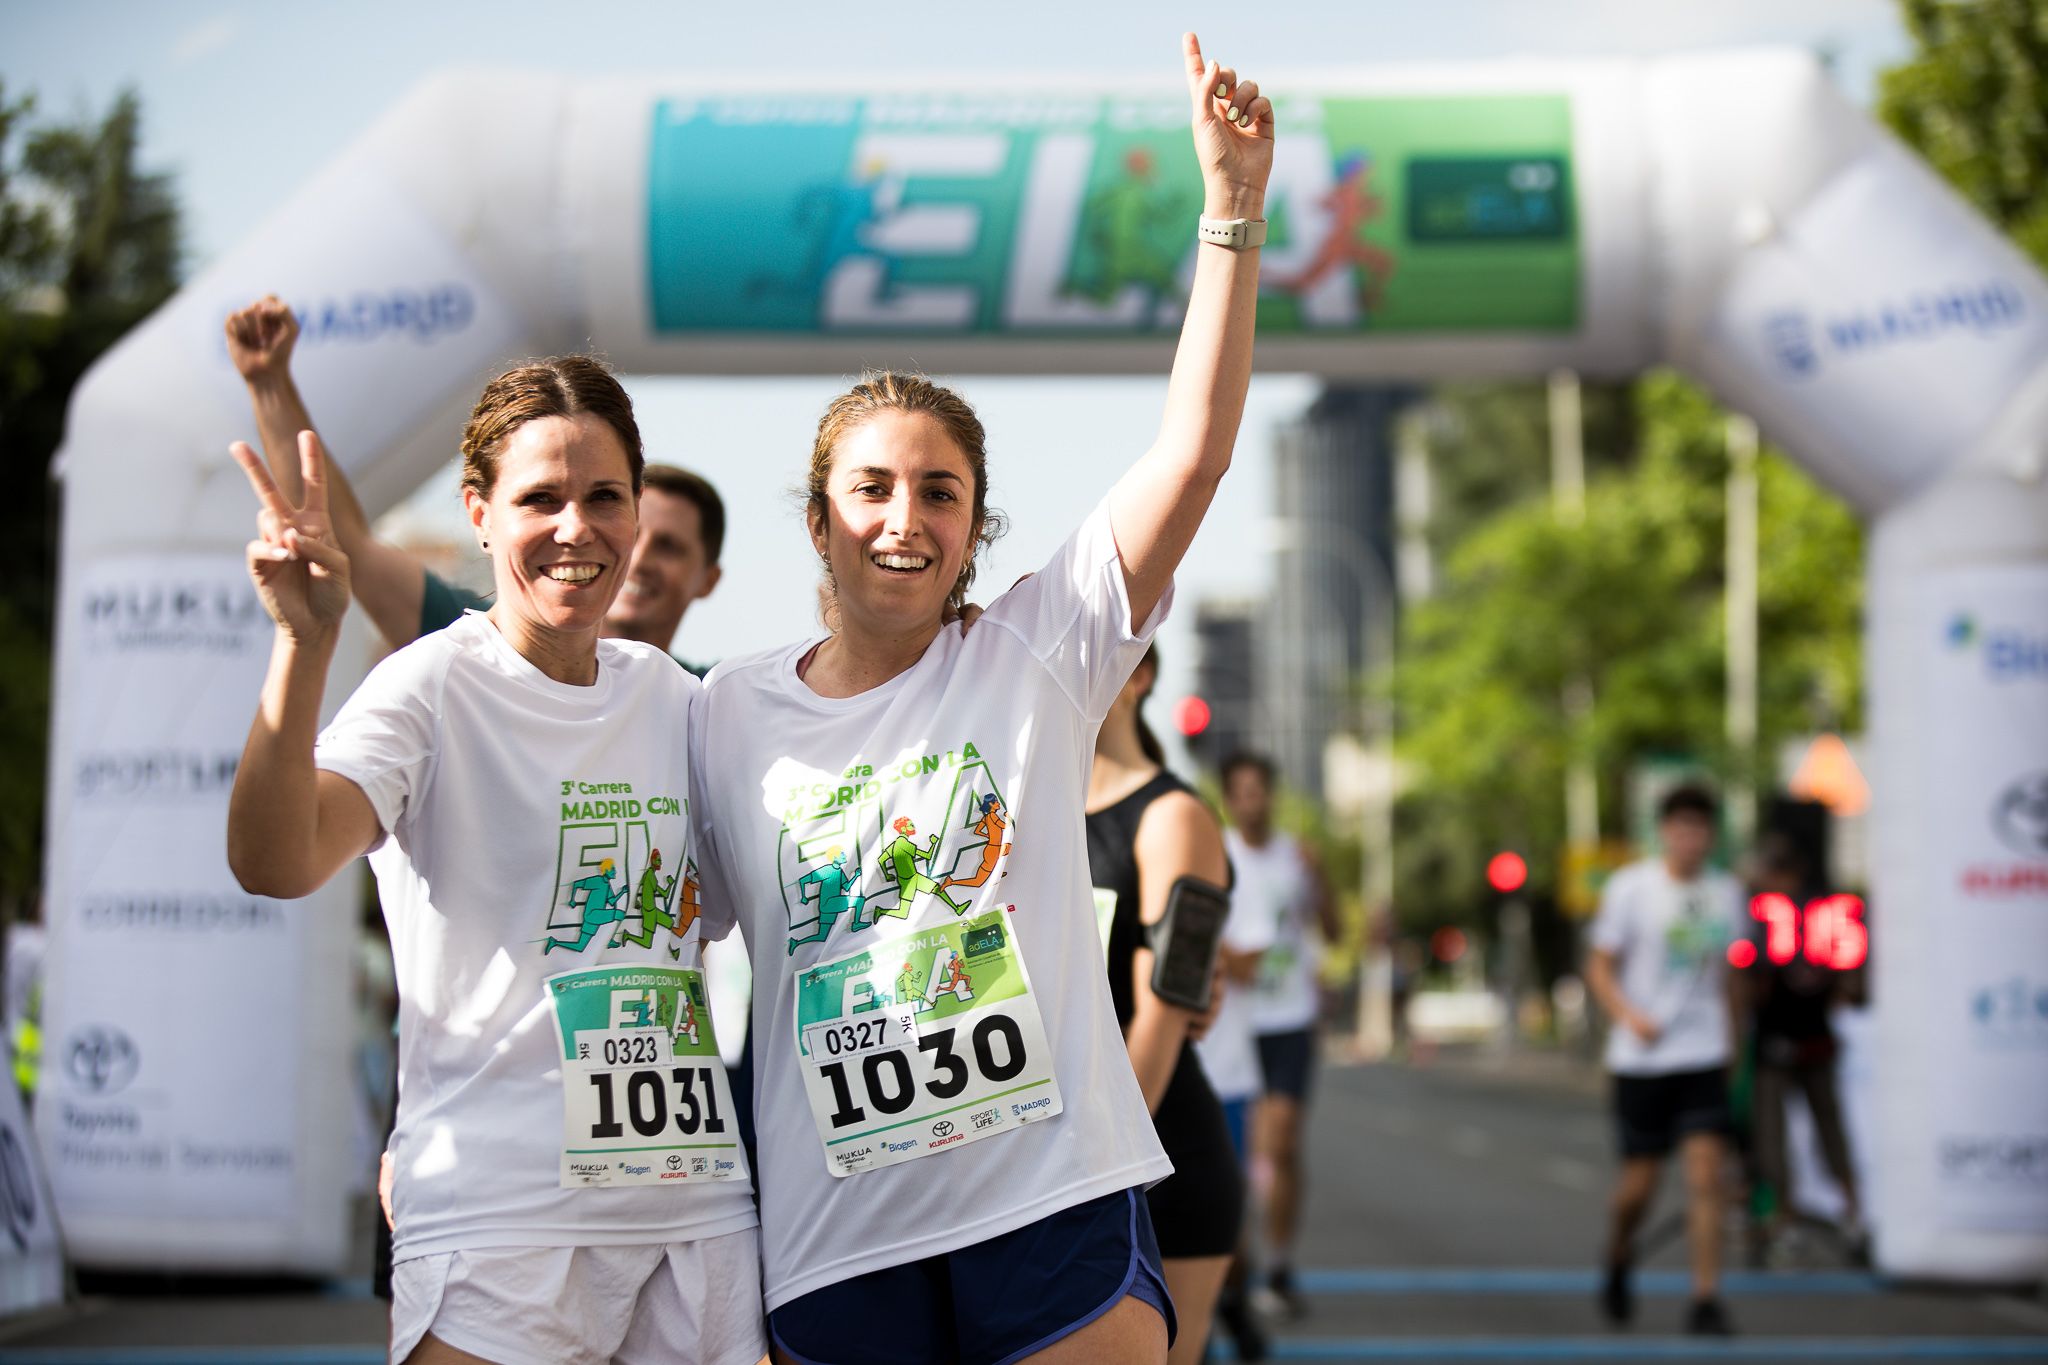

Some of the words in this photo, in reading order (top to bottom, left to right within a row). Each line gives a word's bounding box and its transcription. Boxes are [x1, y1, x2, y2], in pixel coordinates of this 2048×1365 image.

[85, 581, 277, 625] MUKU
[946, 741, 981, 769] LA
[578, 781, 633, 795] Carrera
[560, 799, 642, 821] MADRID
[646, 796, 681, 816] CON
[930, 933, 948, 948] LA
[968, 936, 1000, 953] adELA
[571, 978, 608, 990] Carrera
[610, 974, 655, 987] MADRID
[656, 975, 673, 987] CON
[900, 1015, 913, 1034] 5K
[825, 1017, 888, 1056] 0327
[579, 1042, 591, 1061] 5K
[604, 1036, 658, 1066] 0323
[820, 1014, 1027, 1129] 1030
[590, 1067, 725, 1138] 1031
[1020, 1097, 1051, 1112] MADRID
[969, 1108, 994, 1122] SPORT
[975, 1117, 994, 1129] LIFE
[888, 1139, 918, 1153] Biogen
[836, 1147, 873, 1162] MUKUA
[570, 1163, 609, 1172] MUKUA
[624, 1164, 651, 1176] Biogen
